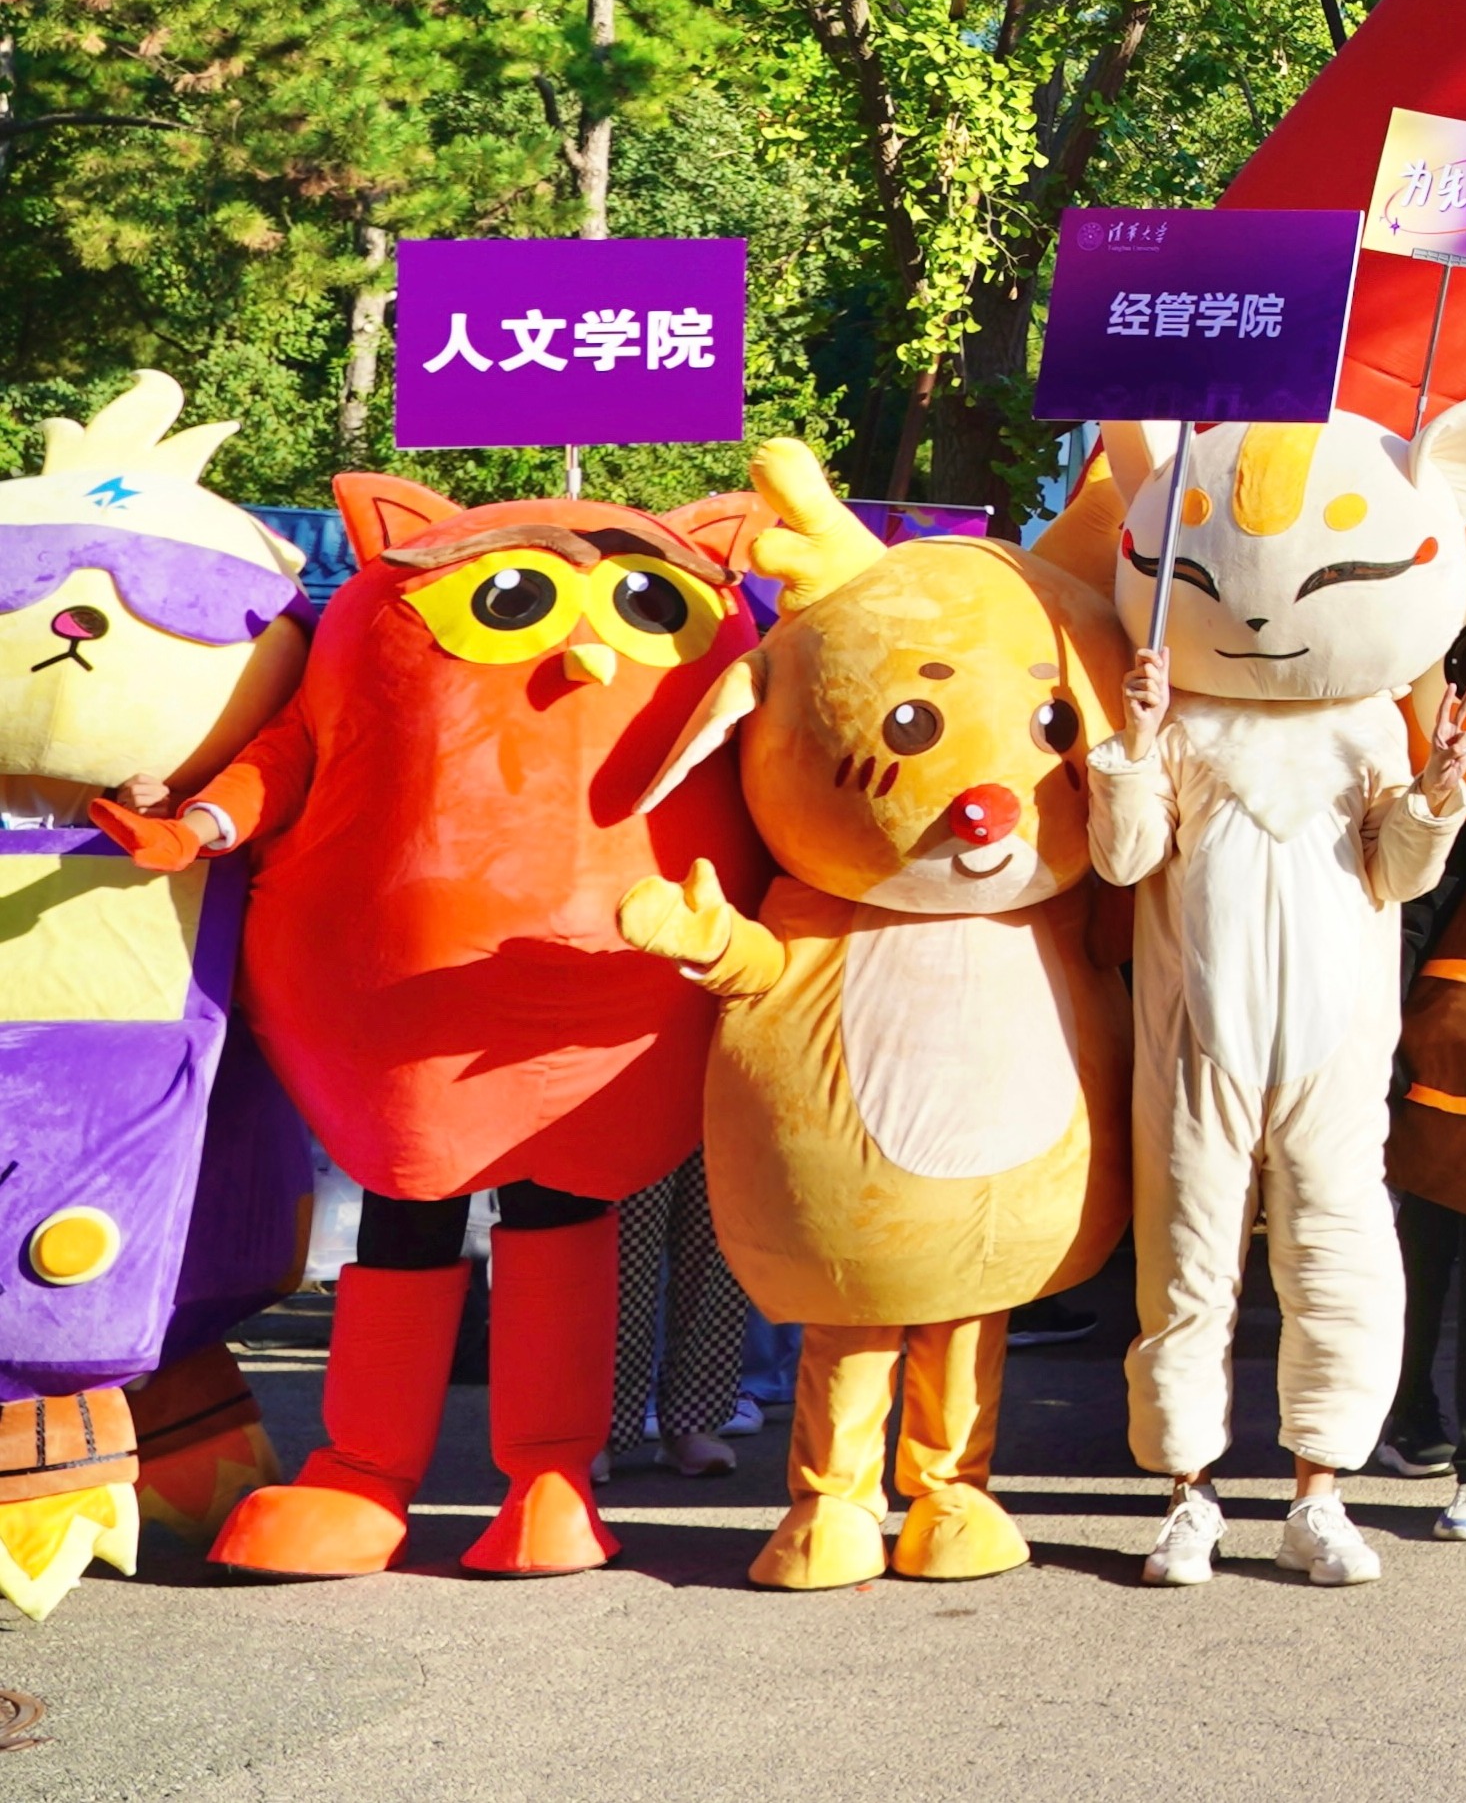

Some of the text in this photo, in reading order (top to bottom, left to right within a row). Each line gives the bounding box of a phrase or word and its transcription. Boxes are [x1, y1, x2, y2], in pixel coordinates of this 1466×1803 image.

[422, 307, 716, 373] 人文学院
[1106, 291, 1285, 339] 经管学院
